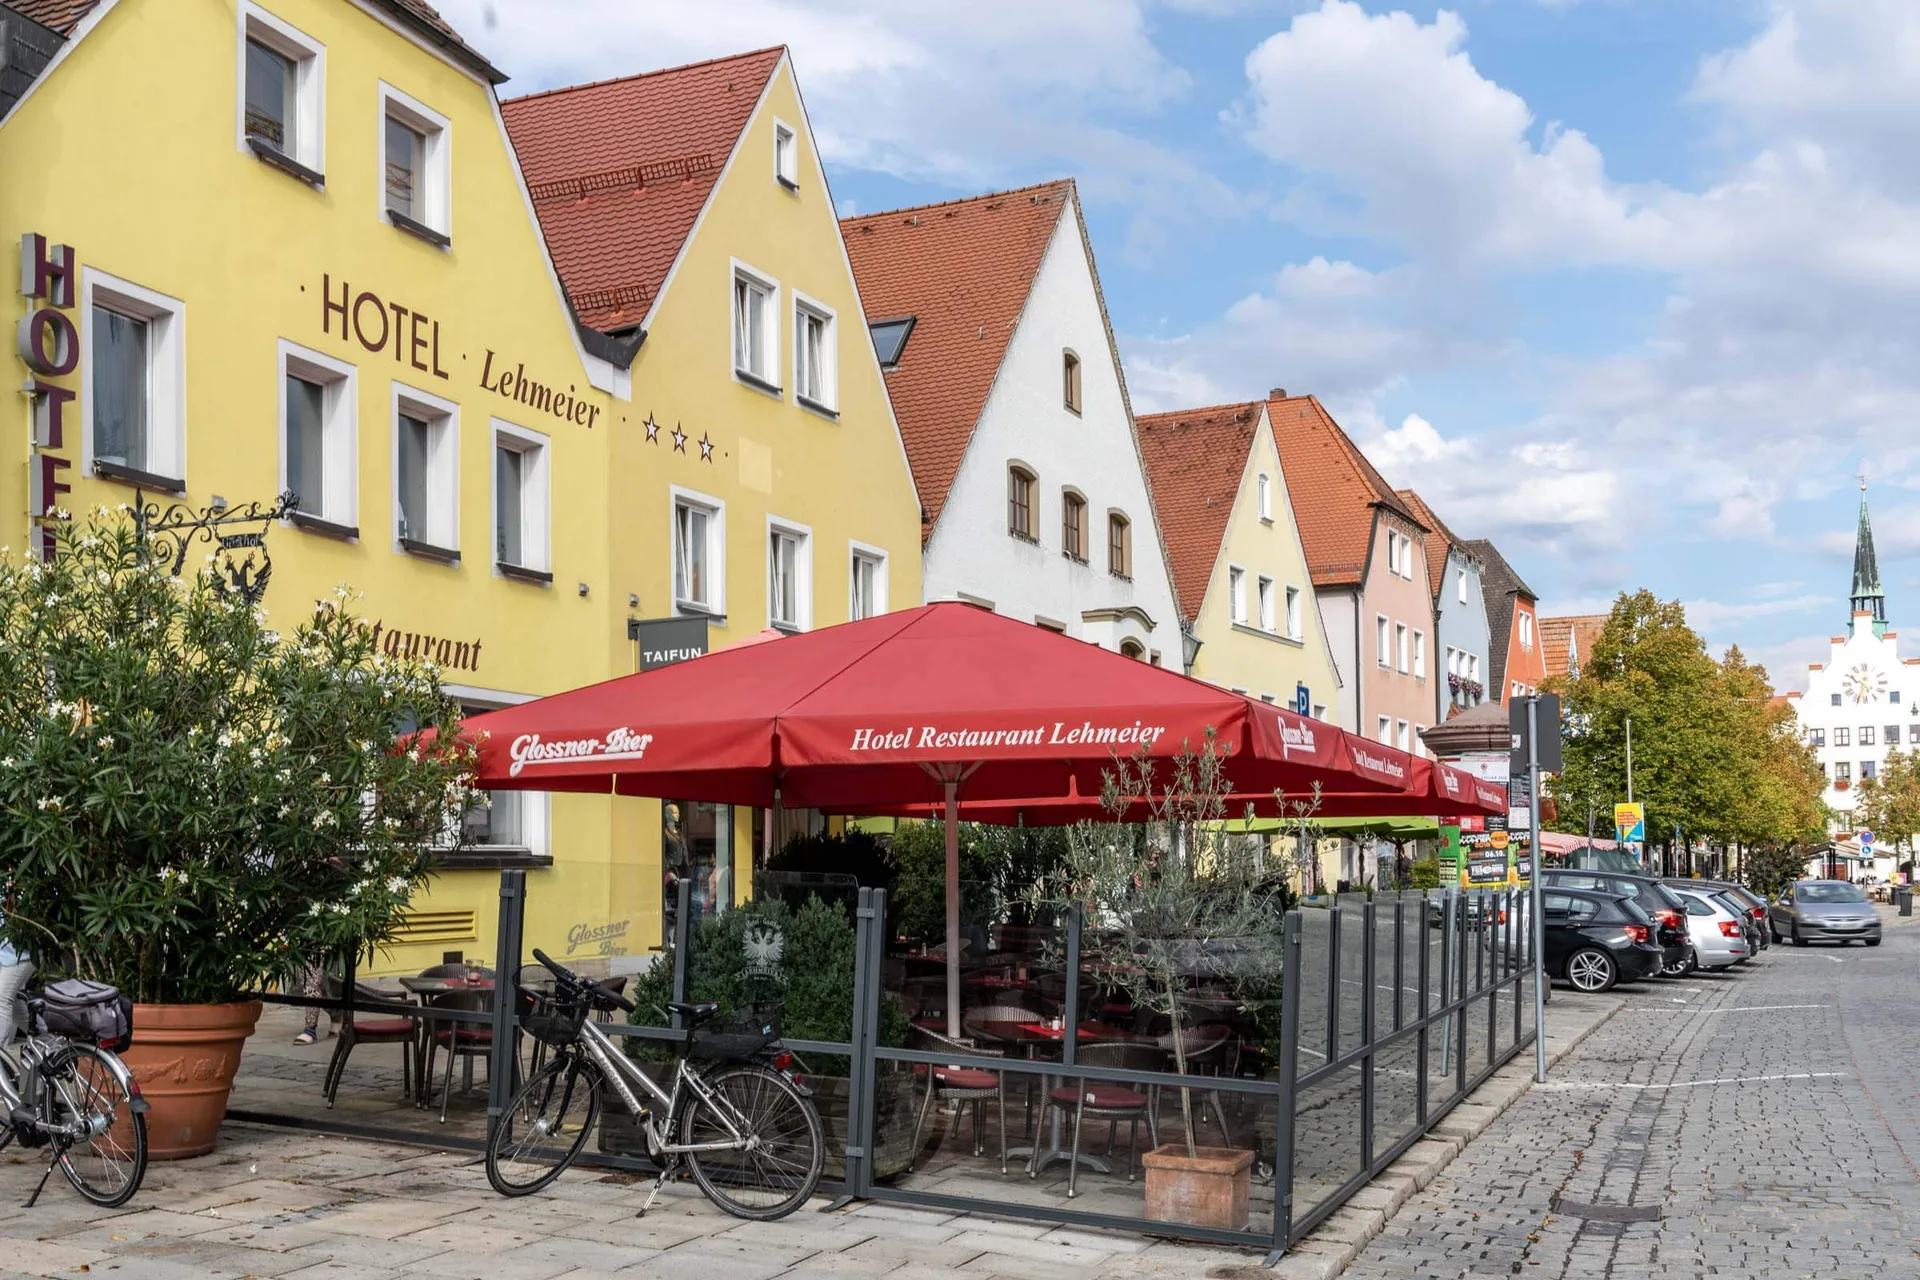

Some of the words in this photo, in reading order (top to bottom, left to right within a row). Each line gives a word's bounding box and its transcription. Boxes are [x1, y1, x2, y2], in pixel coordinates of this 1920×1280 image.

[322, 273, 449, 380] HOTEL
[479, 349, 600, 429] Lehmeier
[643, 647, 702, 663] TAIFUN
[1299, 691, 1307, 715] P
[850, 727, 913, 750] Hotel
[916, 725, 1045, 748] Restaurant
[1048, 720, 1165, 745] Lehmeier
[1485, 850, 1506, 858] 06.10.
[567, 920, 630, 955] Glossner
[599, 940, 628, 956] Bier
